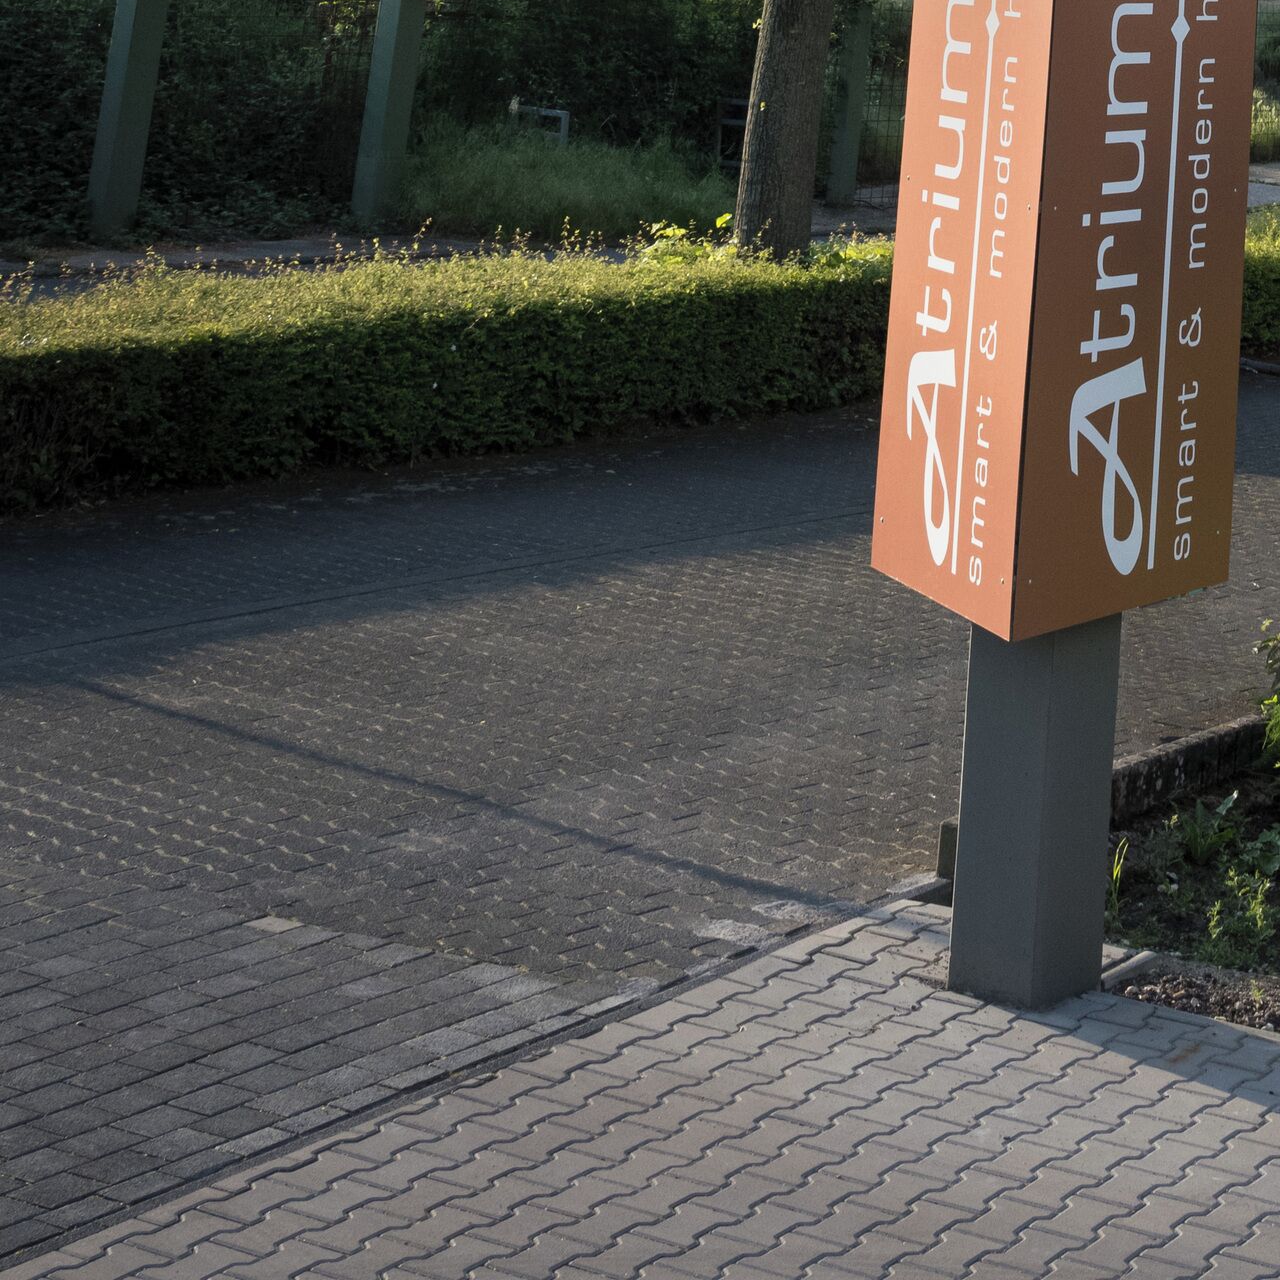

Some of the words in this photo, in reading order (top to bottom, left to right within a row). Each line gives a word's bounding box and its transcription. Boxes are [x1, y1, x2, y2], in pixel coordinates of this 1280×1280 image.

[990, 56, 1019, 278] modern
[1187, 57, 1215, 269] modern
[979, 319, 998, 361] &
[1069, 2, 1153, 576] Atrium
[1178, 306, 1203, 348] &
[968, 396, 993, 586] smart
[1173, 381, 1199, 561] smart
